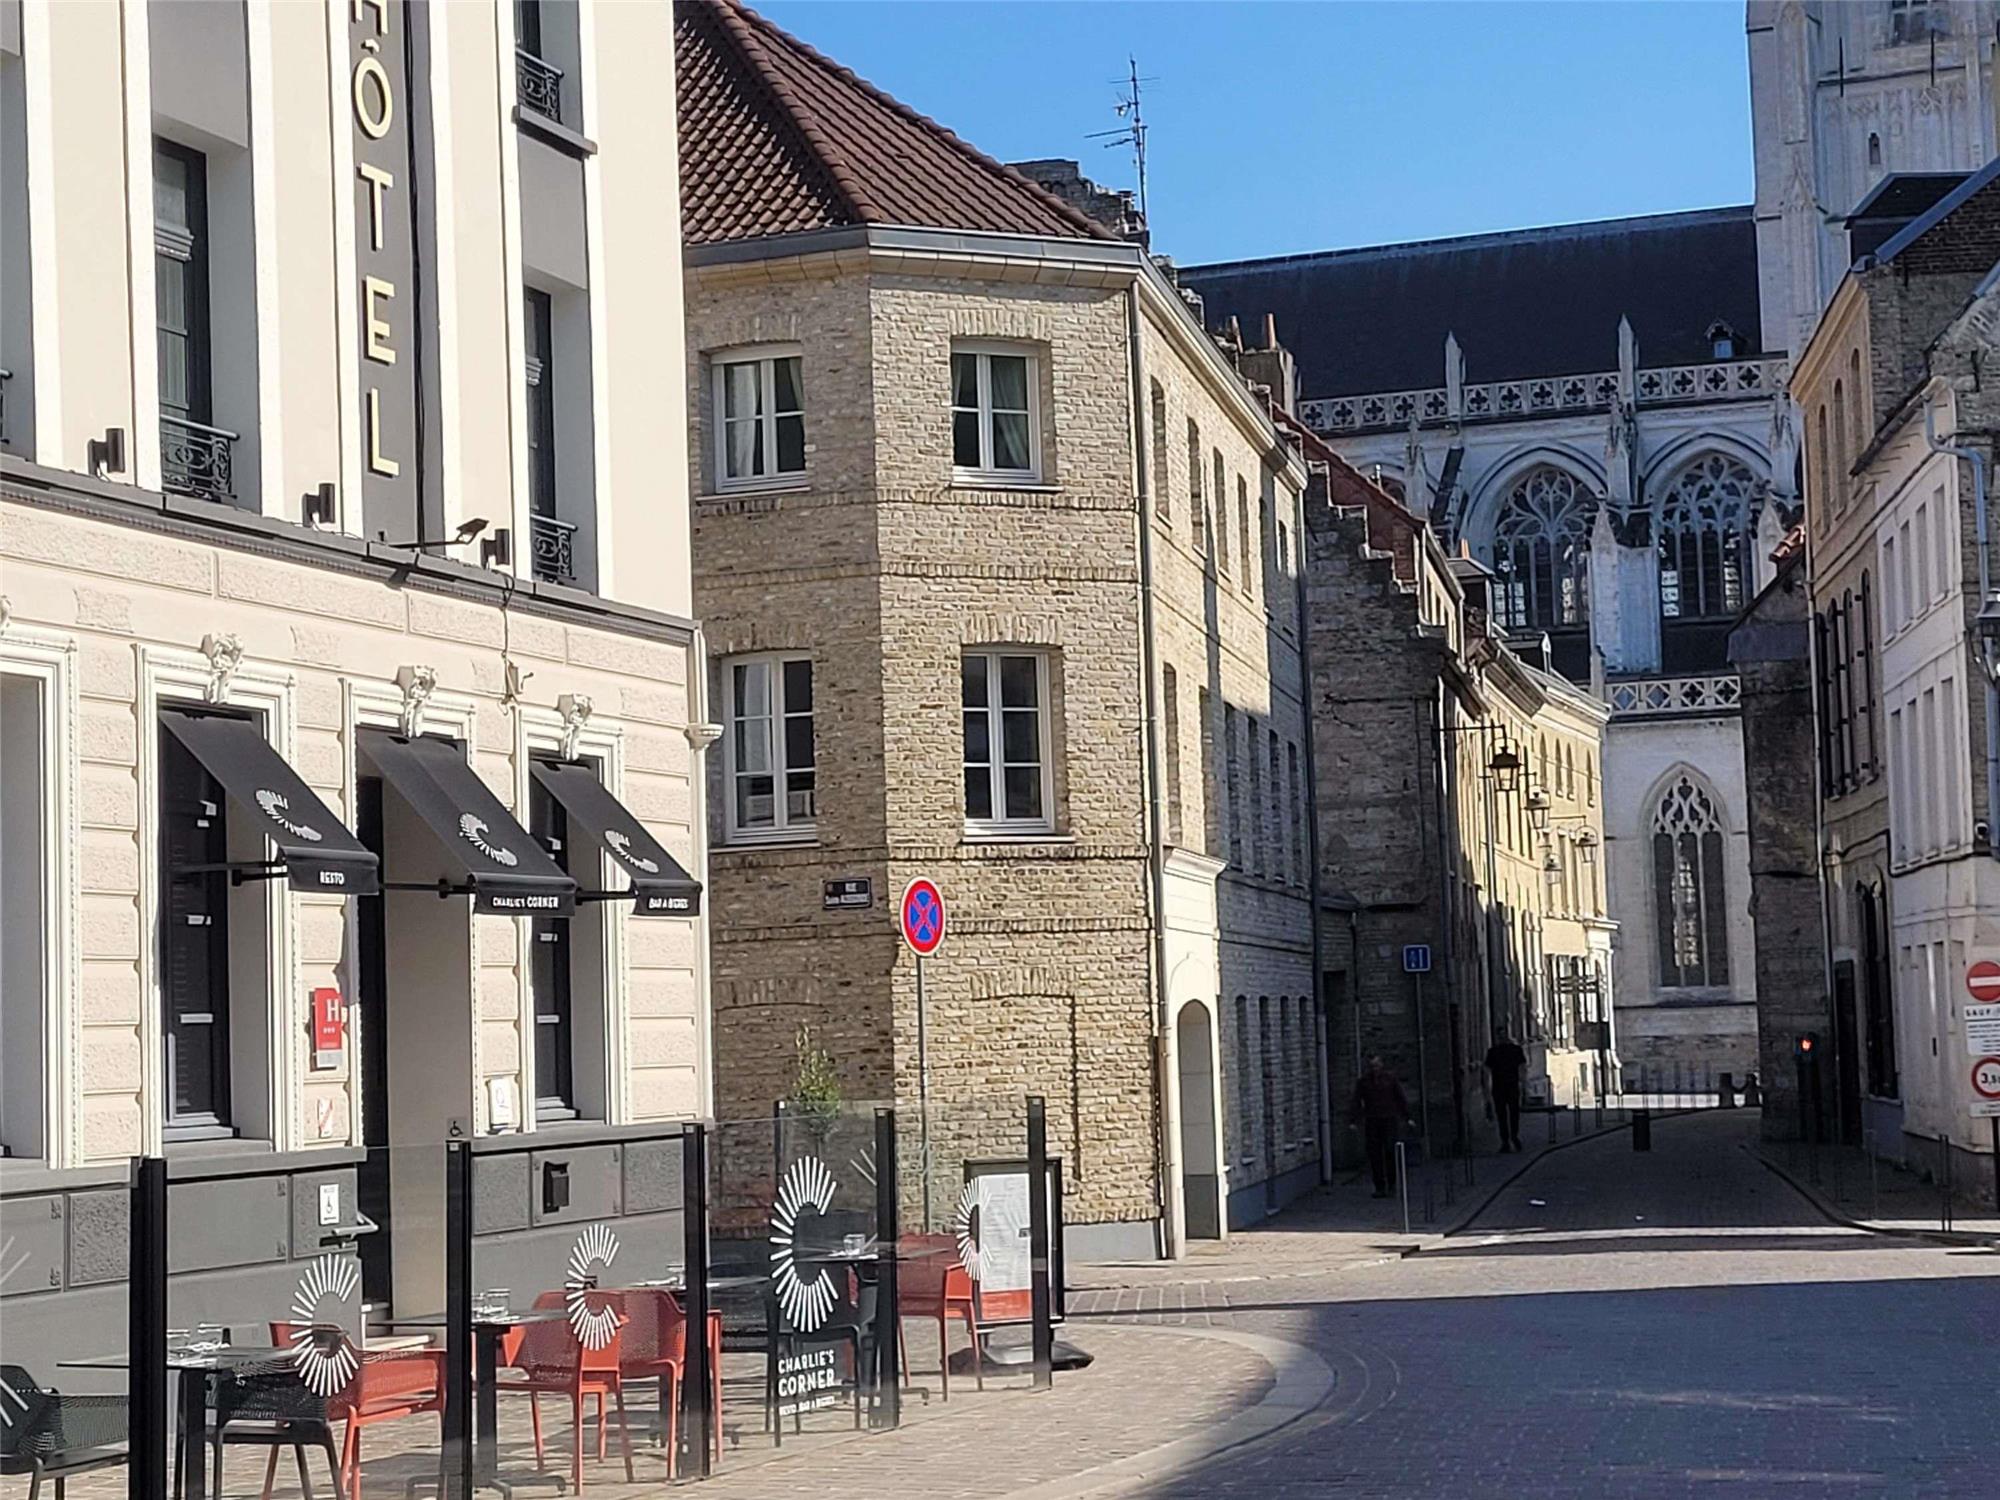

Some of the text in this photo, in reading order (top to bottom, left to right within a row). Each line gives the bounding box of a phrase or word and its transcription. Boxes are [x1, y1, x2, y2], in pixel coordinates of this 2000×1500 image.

[320, 871, 345, 885] RESTO
[526, 895, 559, 909] CORNER
[326, 998, 339, 1022] H
[778, 1348, 835, 1374] CHARLIE'S
[778, 1368, 836, 1397] CORNER
